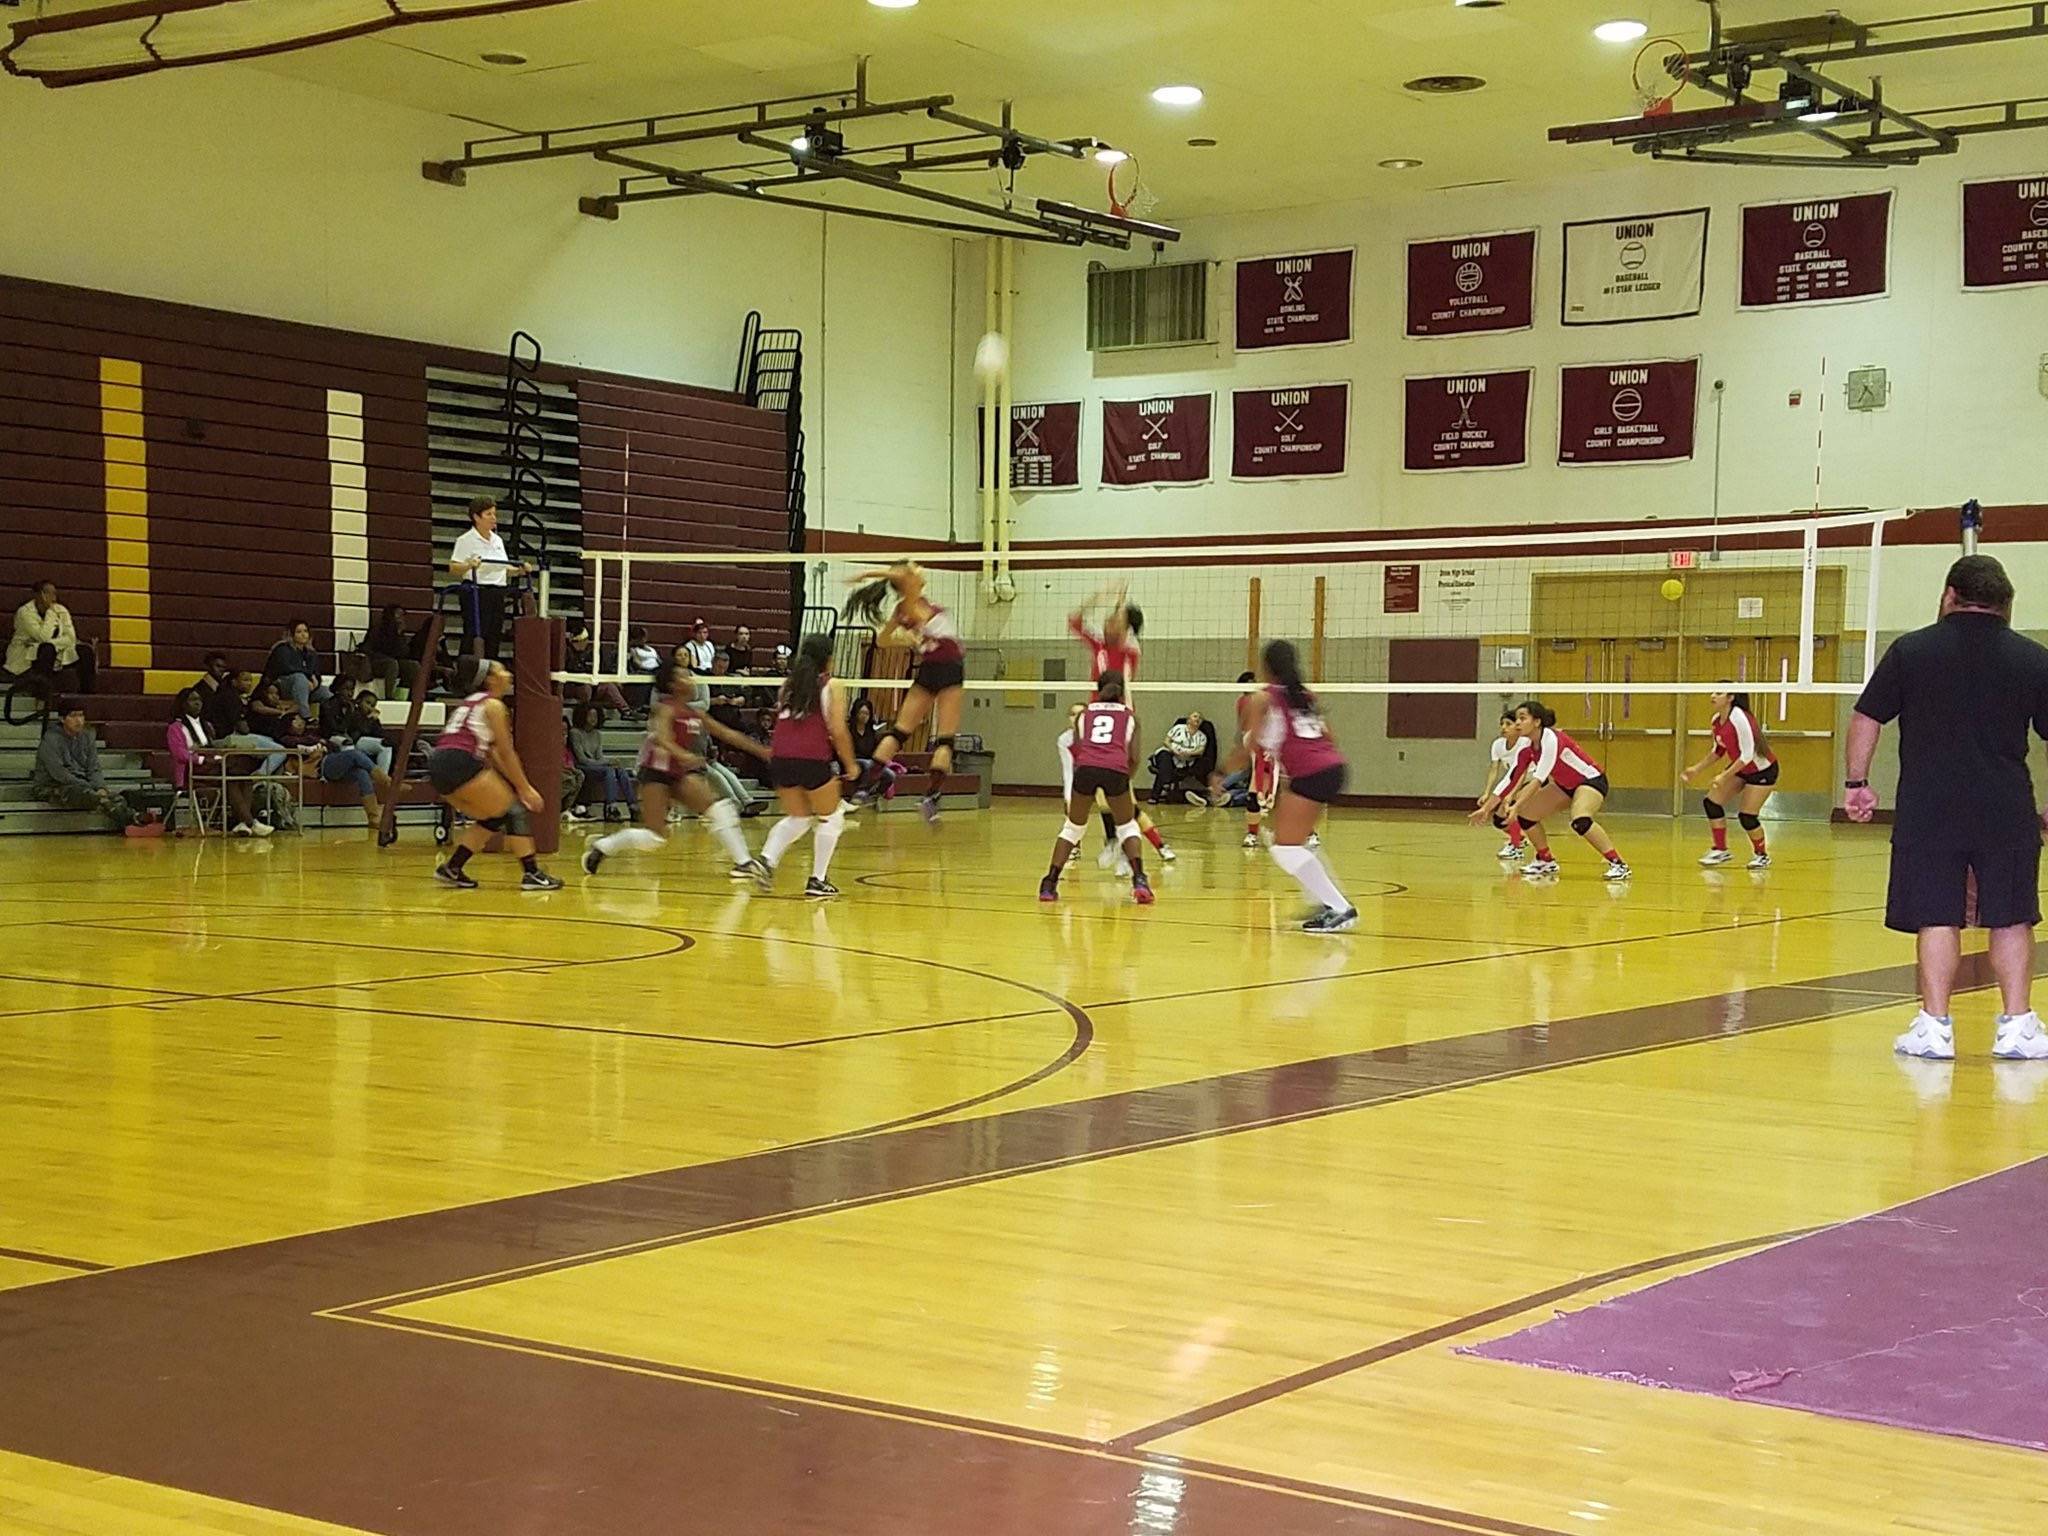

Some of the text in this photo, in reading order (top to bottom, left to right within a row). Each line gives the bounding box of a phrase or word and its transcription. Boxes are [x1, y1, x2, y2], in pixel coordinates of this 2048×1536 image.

[2017, 181, 2048, 199] UNI
[1792, 202, 1840, 222] UNION
[1615, 222, 1654, 240] UNION
[1452, 241, 1491, 260] UNION
[2002, 242, 2034, 254] COUNTY
[1794, 249, 1831, 261] BASEBALL
[1275, 258, 1313, 275] UNION
[1778, 259, 1848, 274] STATE CHAMPIONS
[1615, 273, 1649, 283] BASEBALL
[1616, 285, 1632, 294] STAR
[1635, 282, 1661, 292] LEDGER
[1449, 295, 1489, 306] VOLLEYBALL
[1431, 306, 1506, 320] COUNTY CHAMPIONSHIP
[1266, 314, 1319, 326] STATE CHAMPIONS
[1609, 369, 1649, 386] UNION
[1446, 378, 1486, 394] UNION
[1271, 390, 1310, 406] UNION
[1012, 405, 1046, 420] UNION
[1138, 400, 1174, 416] UNION
[1593, 423, 1659, 435] GIRLS BASKETBALL
[1281, 434, 1296, 442] GOLF
[1441, 430, 1488, 441] FIELD HOCKEY
[1147, 442, 1162, 451] GOLF
[1433, 440, 1495, 452] COUNTY CHAMPIONS
[1585, 436, 1666, 448] COUNTY CHAMPIONSHIP
[1253, 443, 1322, 454] COUNTY CHAMPIONSHIP
[1128, 452, 1181, 463] STATE CHAMPIONS
[1090, 715, 1115, 745] 2
